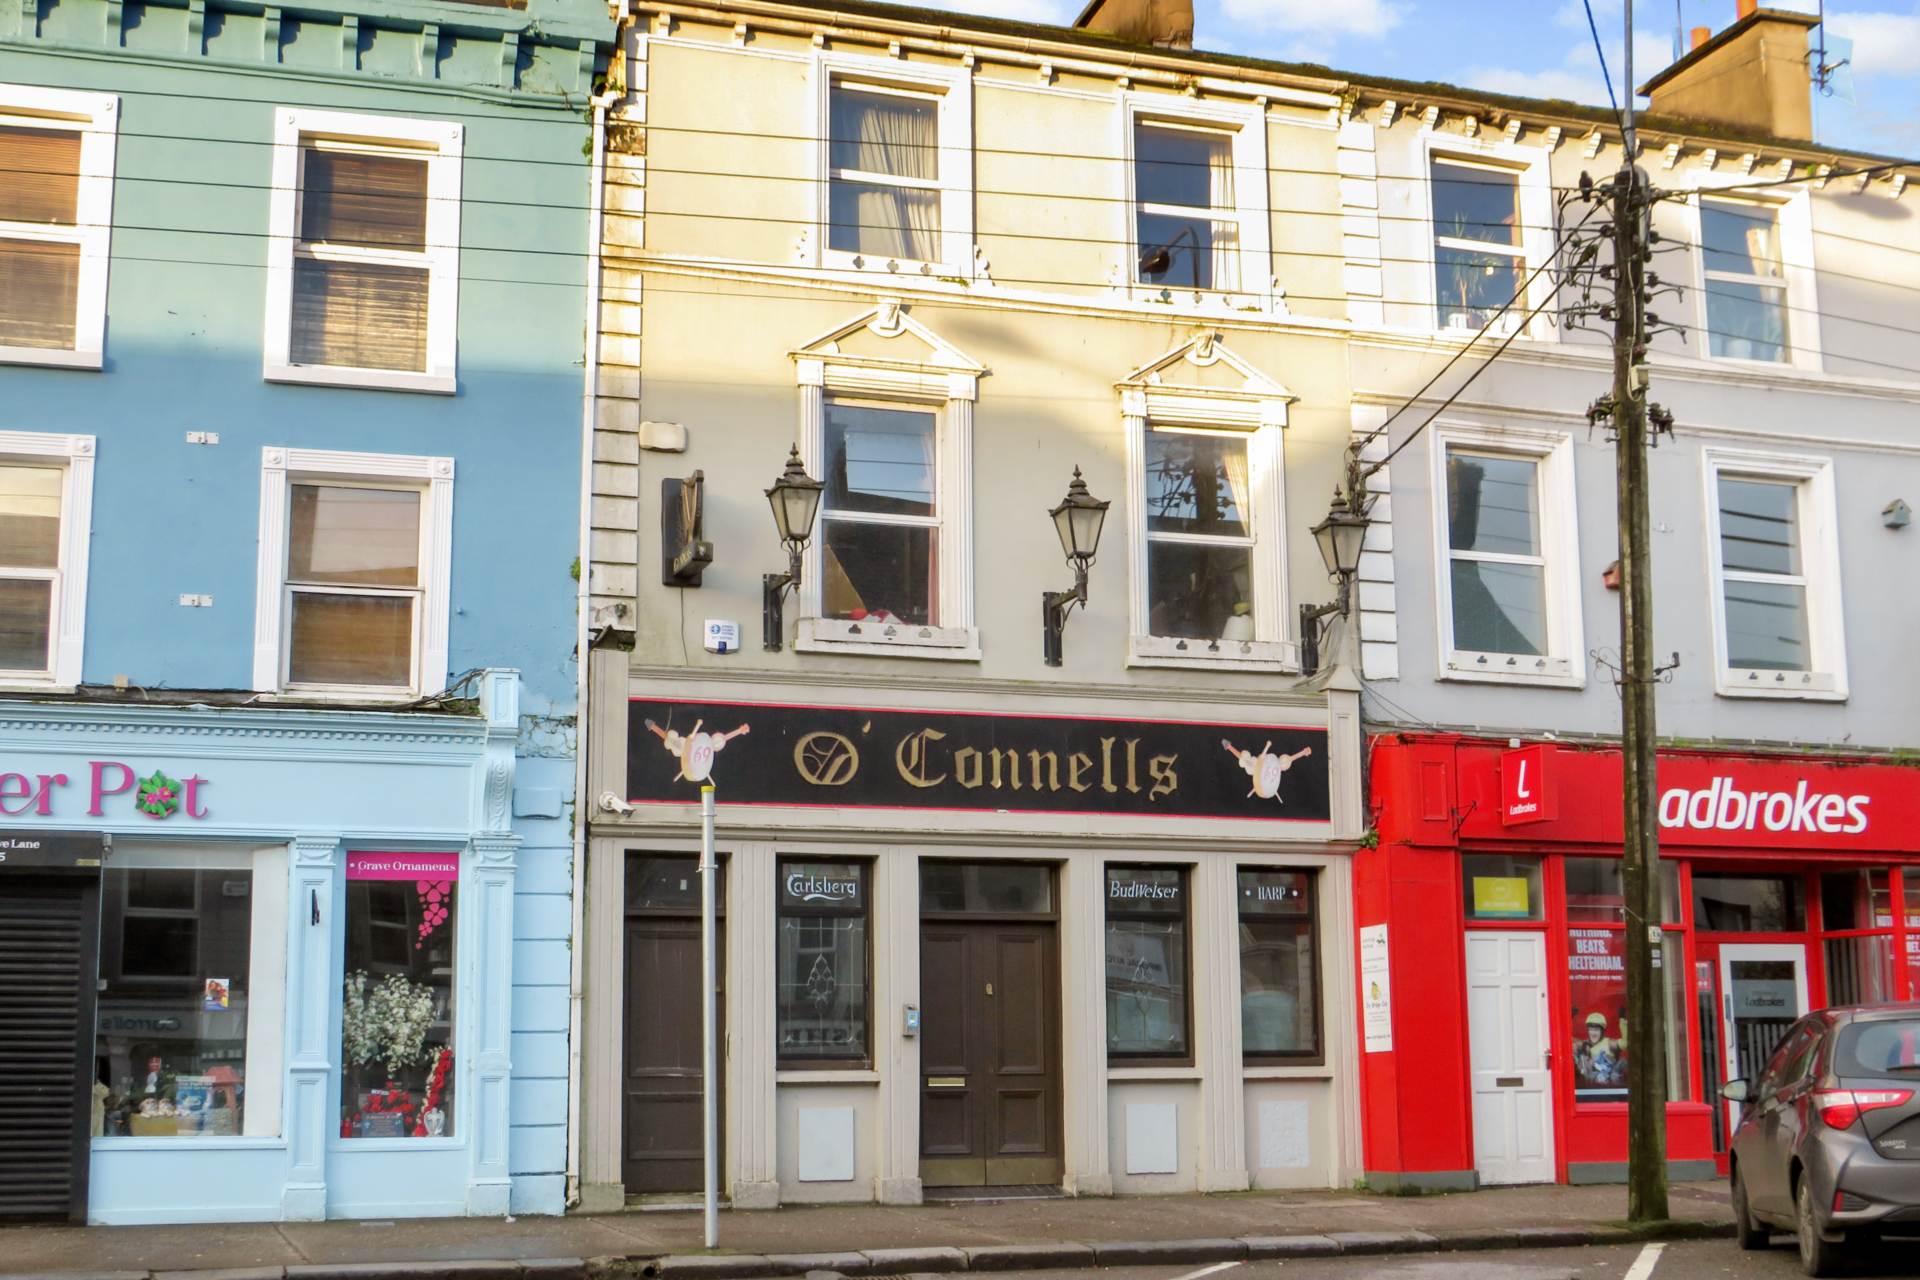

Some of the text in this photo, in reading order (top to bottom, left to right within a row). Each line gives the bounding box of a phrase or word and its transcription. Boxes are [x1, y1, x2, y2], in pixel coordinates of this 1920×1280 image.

[895, 728, 1178, 801] Connells
[1658, 776, 1870, 834] adbrokes
[11, 839, 41, 850] Lane
[358, 860, 456, 875] Grave Ornaments
[787, 873, 856, 899] Carlsberg
[1258, 886, 1286, 900] HARP
